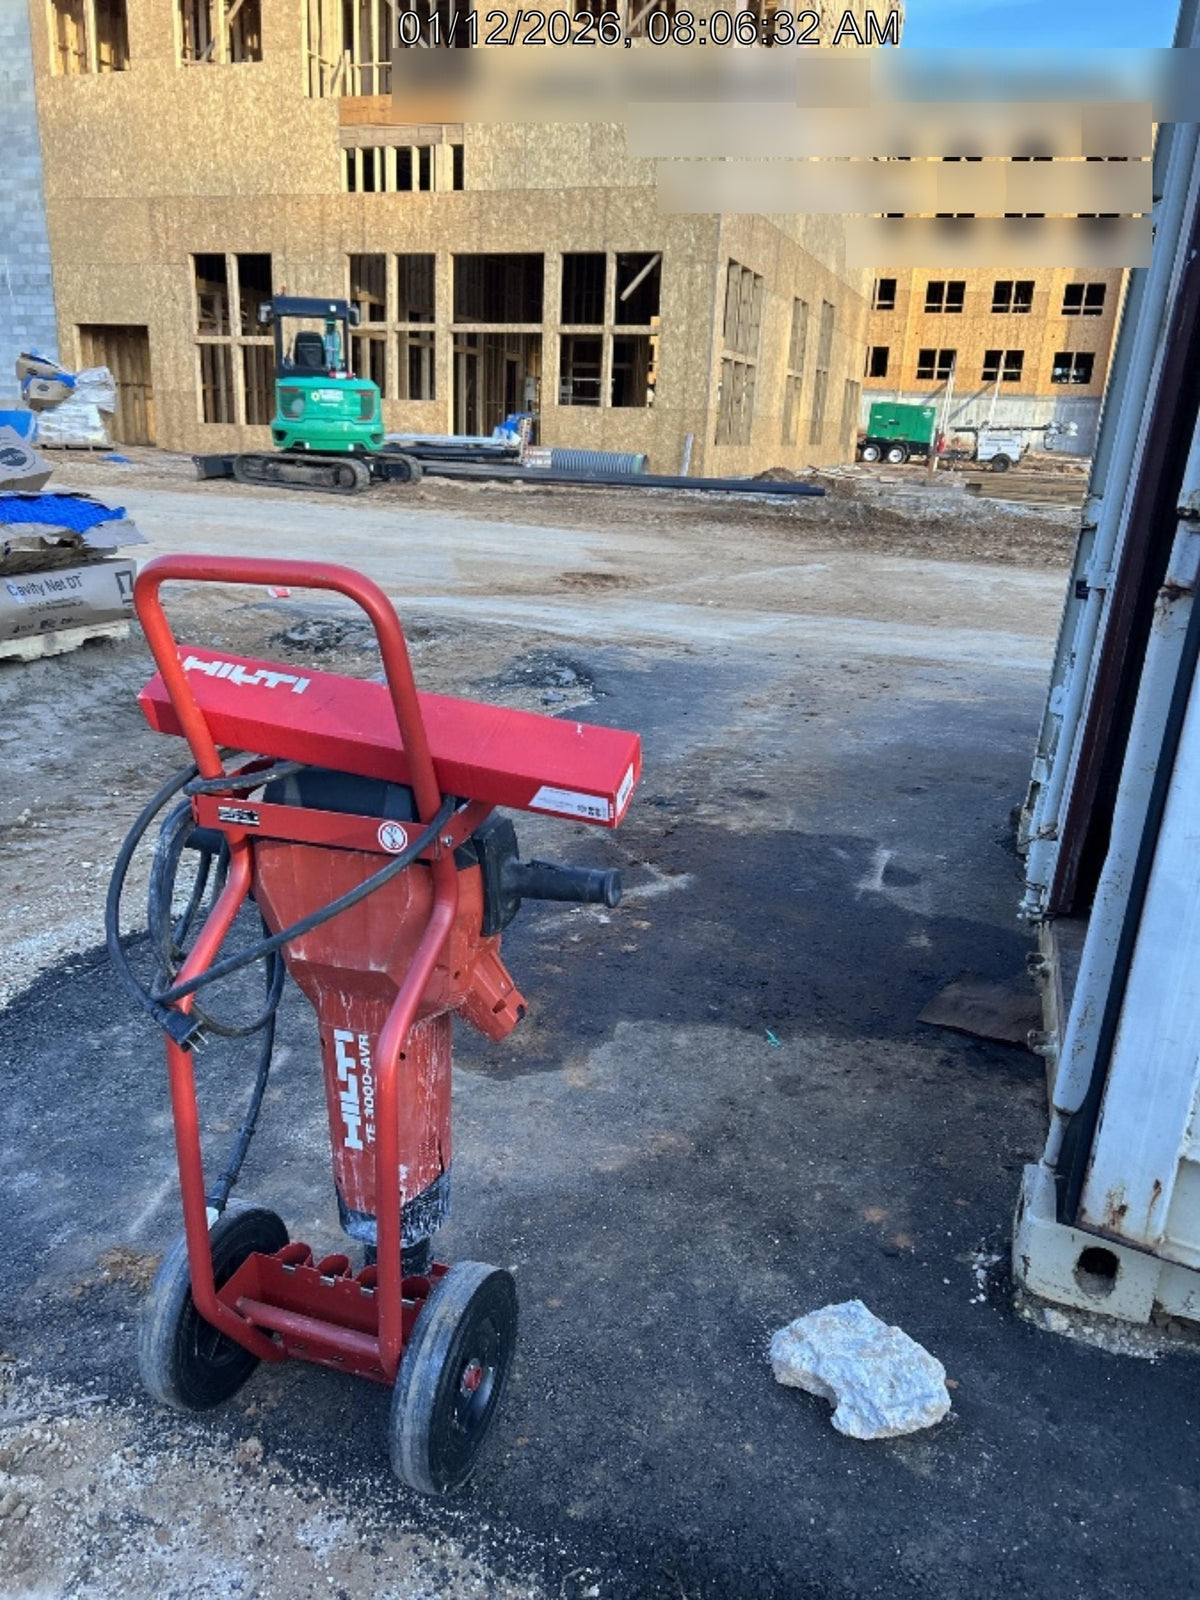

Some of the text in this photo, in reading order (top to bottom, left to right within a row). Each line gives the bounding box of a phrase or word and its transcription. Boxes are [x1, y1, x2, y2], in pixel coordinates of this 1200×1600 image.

[6, 580, 46, 597] Cavity
[44, 577, 68, 593] Net
[181, 655, 312, 694] HILTI
[333, 1028, 363, 1151] HILTI
[365, 1122, 376, 1144] TE
